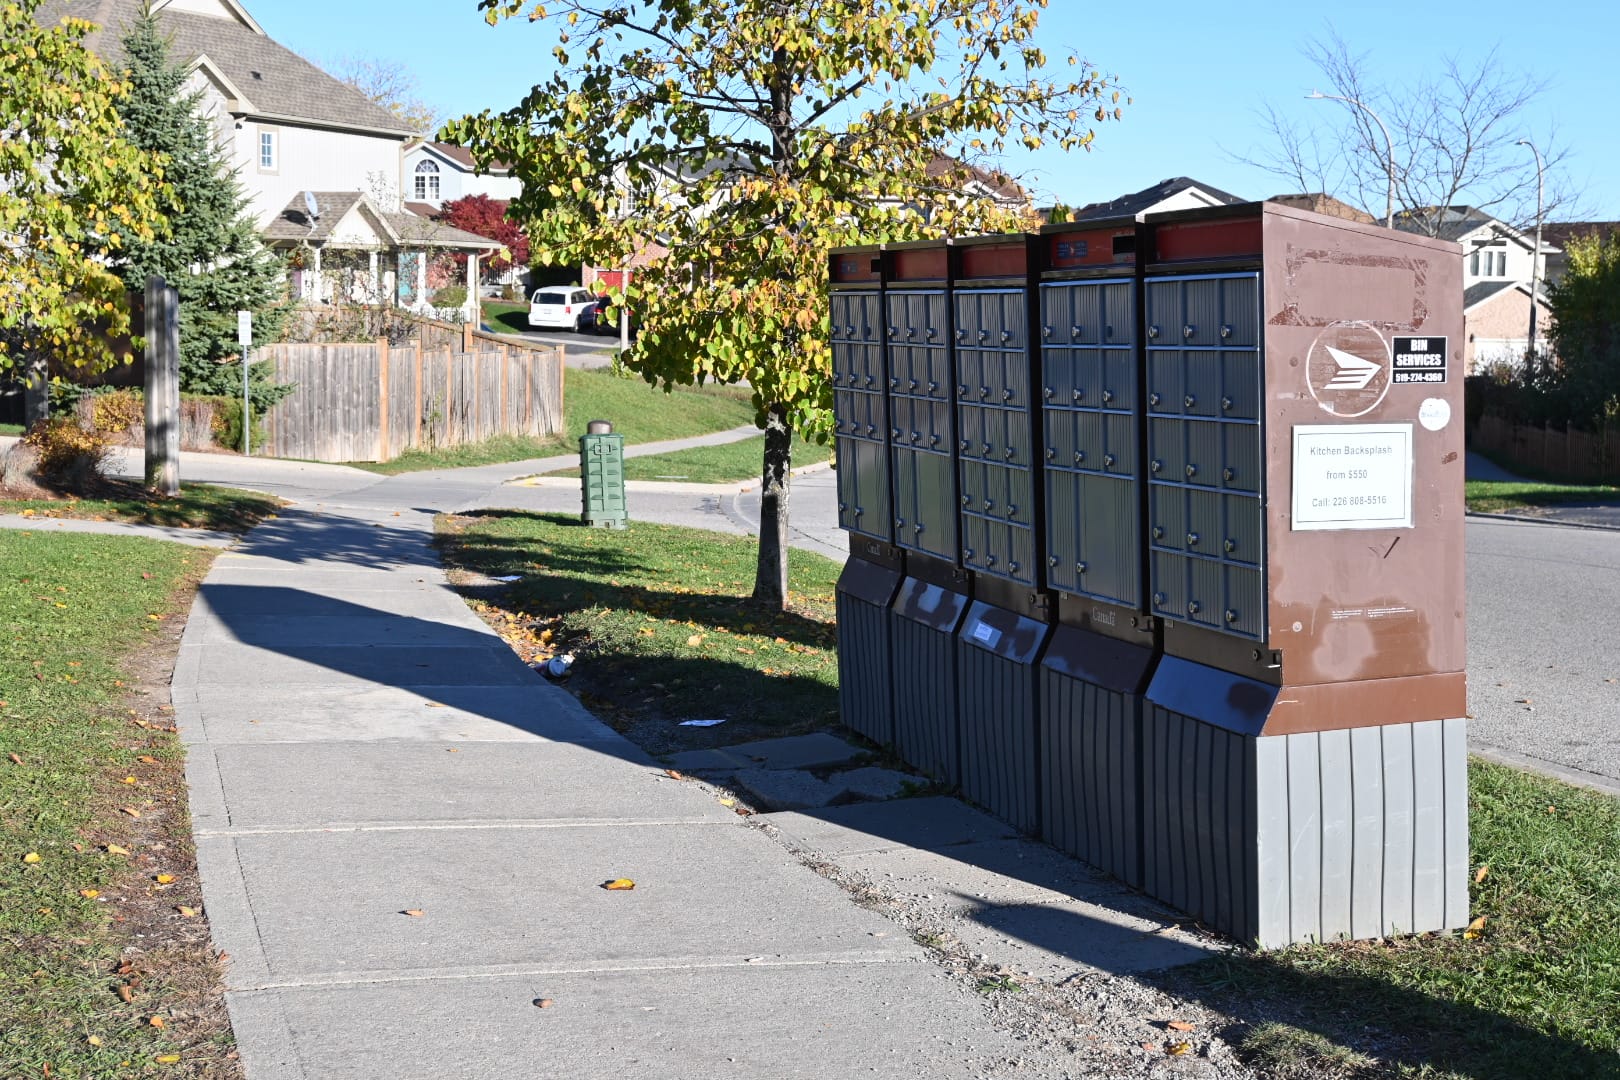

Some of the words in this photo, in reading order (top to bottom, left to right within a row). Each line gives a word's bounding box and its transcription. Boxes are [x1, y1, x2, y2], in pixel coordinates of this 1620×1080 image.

[1410, 339, 1428, 351] BIN
[1396, 353, 1442, 366] SERVICES
[1310, 446, 1342, 456] Kitchen
[1344, 445, 1393, 456] Backsplash
[1326, 470, 1346, 479] from
[1348, 469, 1368, 479] $550
[1312, 497, 1331, 507] Call:
[1333, 496, 1348, 506] 226
